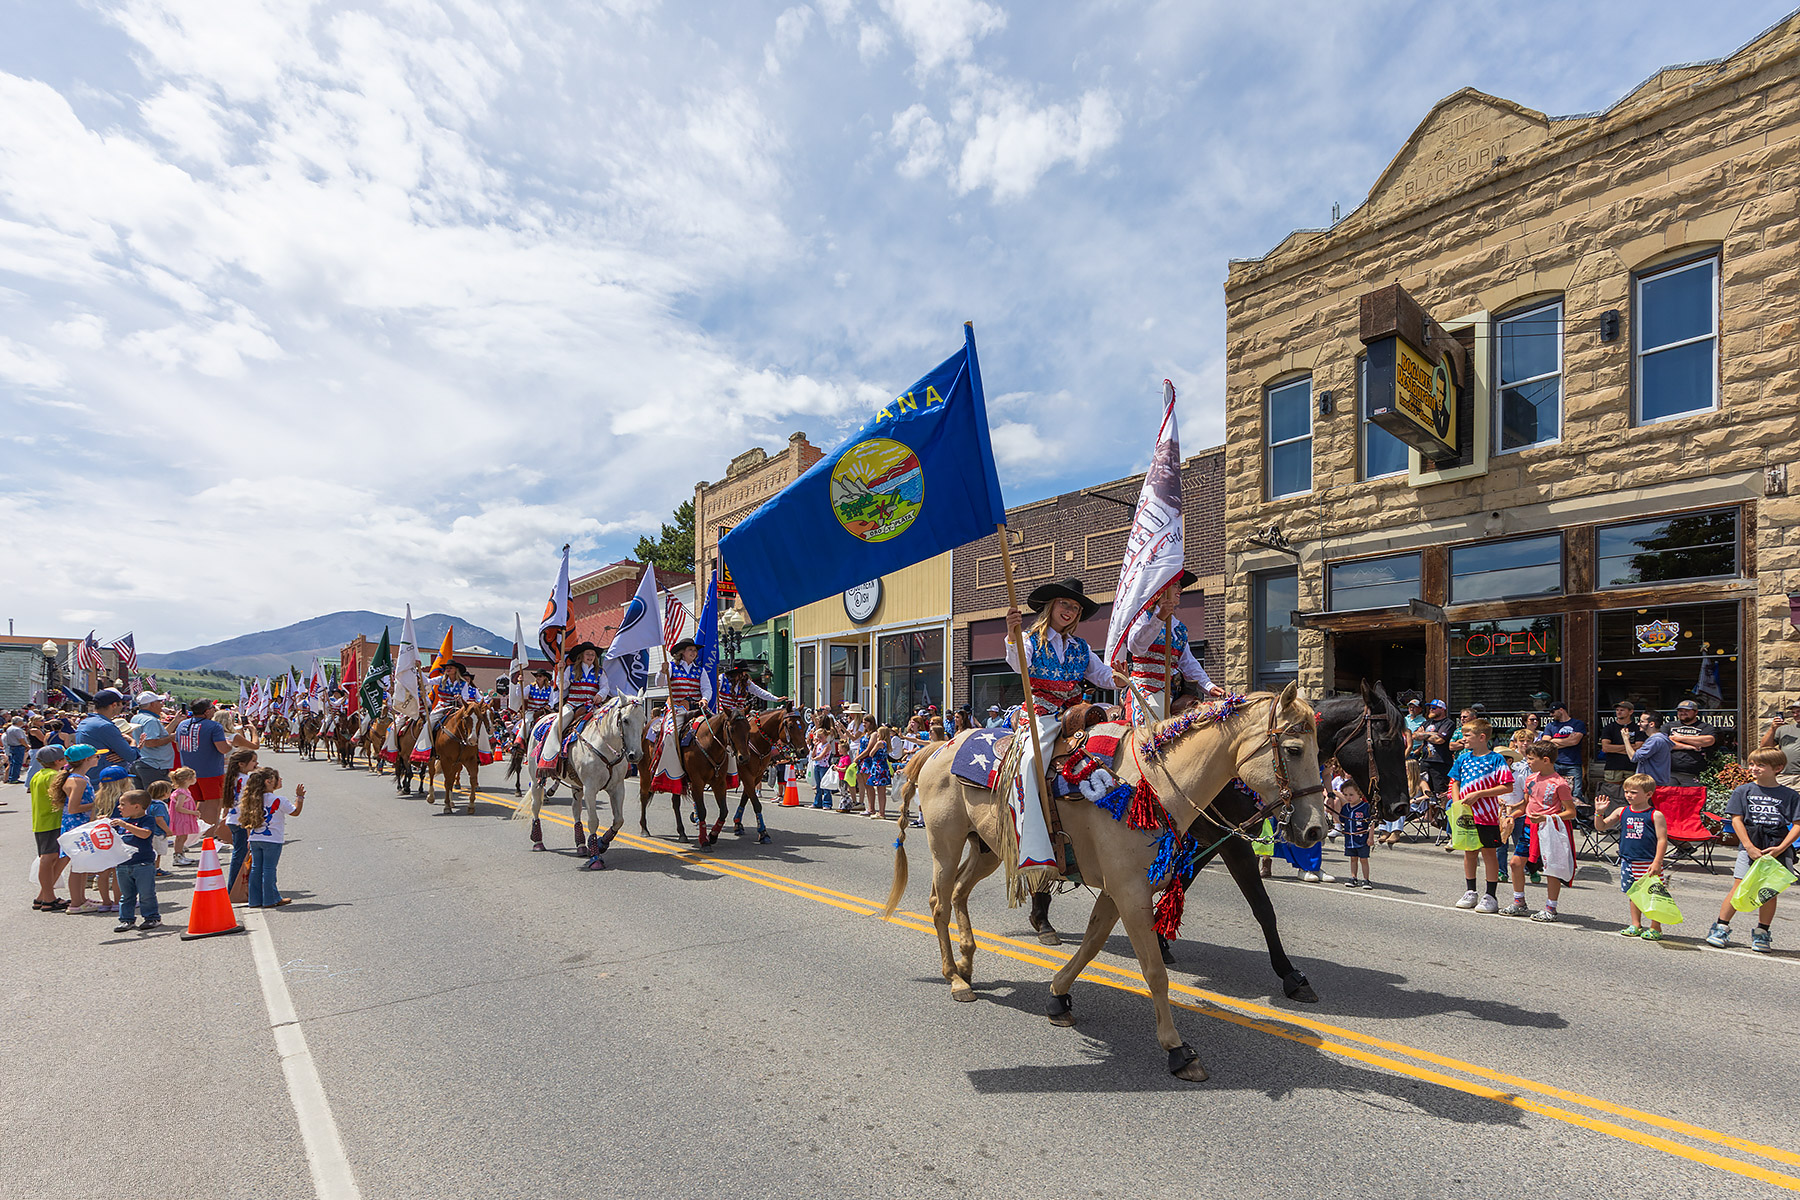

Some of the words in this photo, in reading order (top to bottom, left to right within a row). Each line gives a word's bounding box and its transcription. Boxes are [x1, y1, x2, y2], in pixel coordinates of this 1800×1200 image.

[1404, 141, 1503, 197] BLACKBURN
[1397, 363, 1436, 411] Restaurant
[859, 385, 943, 432] ANA
[1466, 631, 1547, 656] OPEN
[1649, 633, 1666, 642] 50
[1627, 817, 1633, 825] SO
[91, 827, 112, 846] IGA
